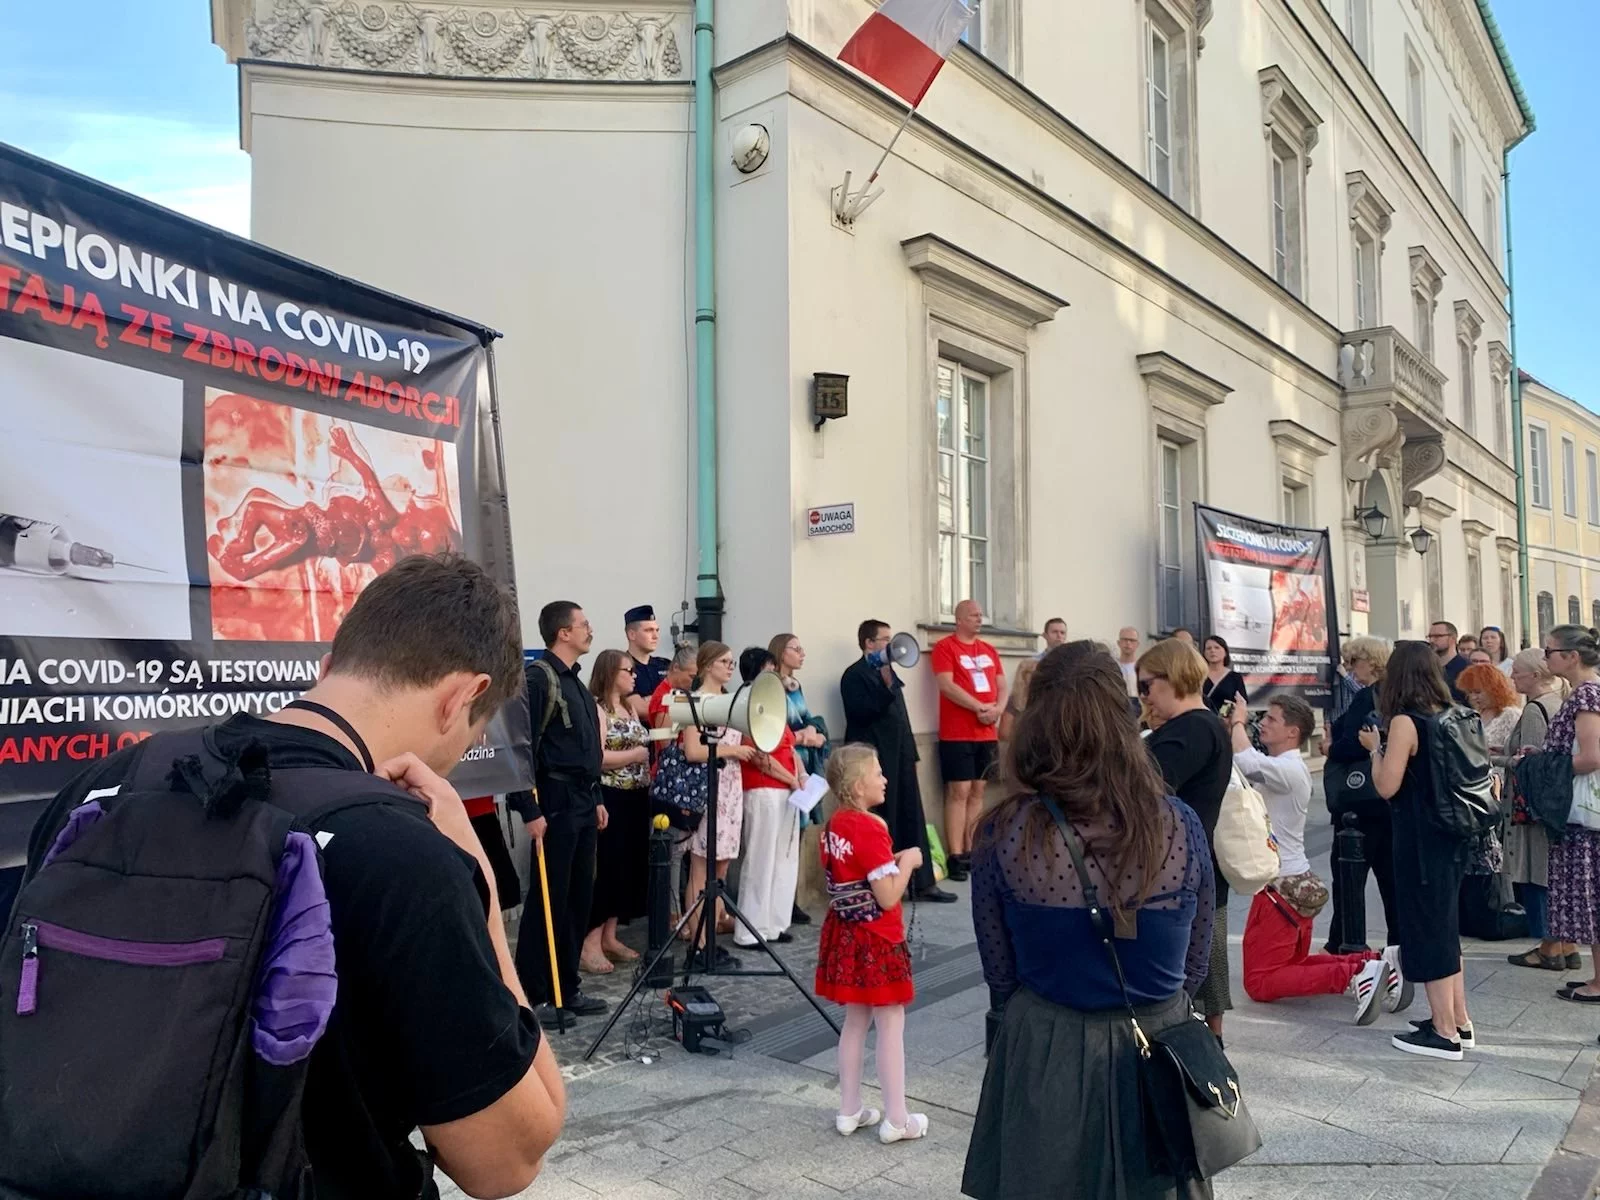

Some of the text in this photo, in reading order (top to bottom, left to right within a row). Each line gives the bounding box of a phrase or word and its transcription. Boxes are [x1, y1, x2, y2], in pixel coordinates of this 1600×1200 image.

[0, 201, 430, 375] EPIONKI NA COVID-19
[118, 303, 173, 353] ZE
[182, 322, 341, 398] ZBRODNI
[344, 371, 460, 428] ABORCJI
[821, 511, 852, 523] UWAGA
[38, 659, 163, 684] COVID-19
[169, 660, 204, 689] SĄ
[117, 731, 152, 750] O
